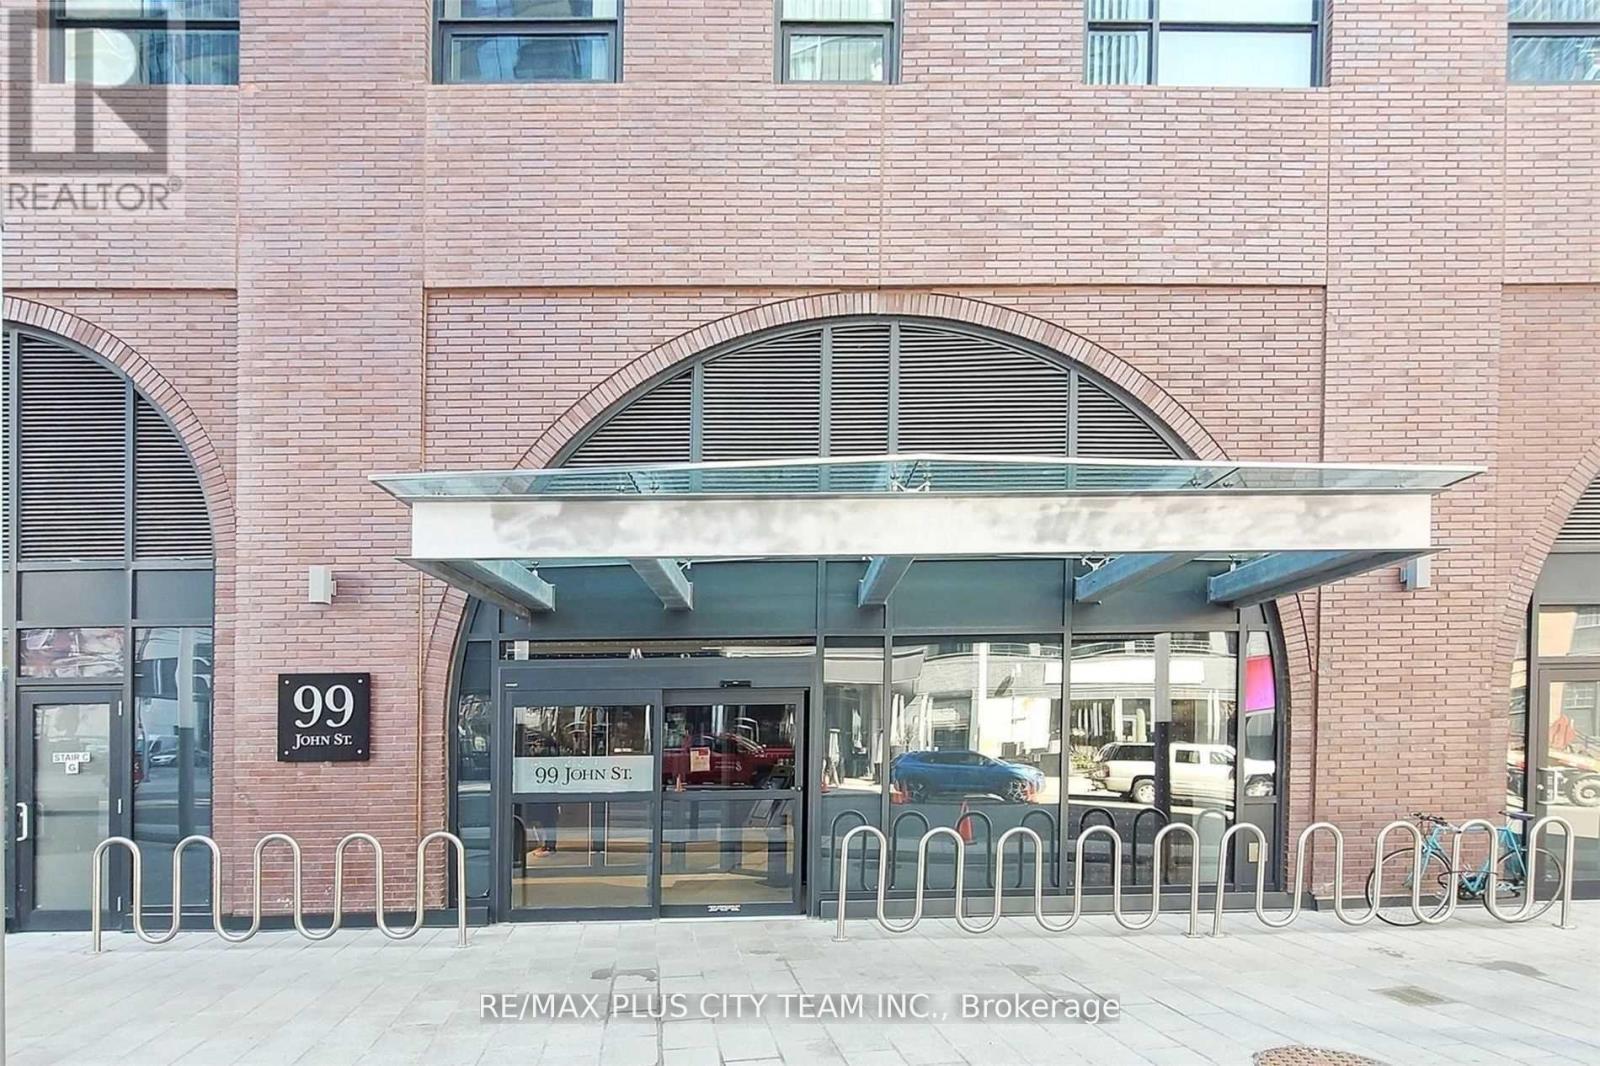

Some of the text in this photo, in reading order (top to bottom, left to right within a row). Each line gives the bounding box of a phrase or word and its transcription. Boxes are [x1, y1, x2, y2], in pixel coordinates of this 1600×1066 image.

[293, 684, 354, 728] 99
[54, 753, 80, 761] STAIR
[535, 766, 559, 784] 99
